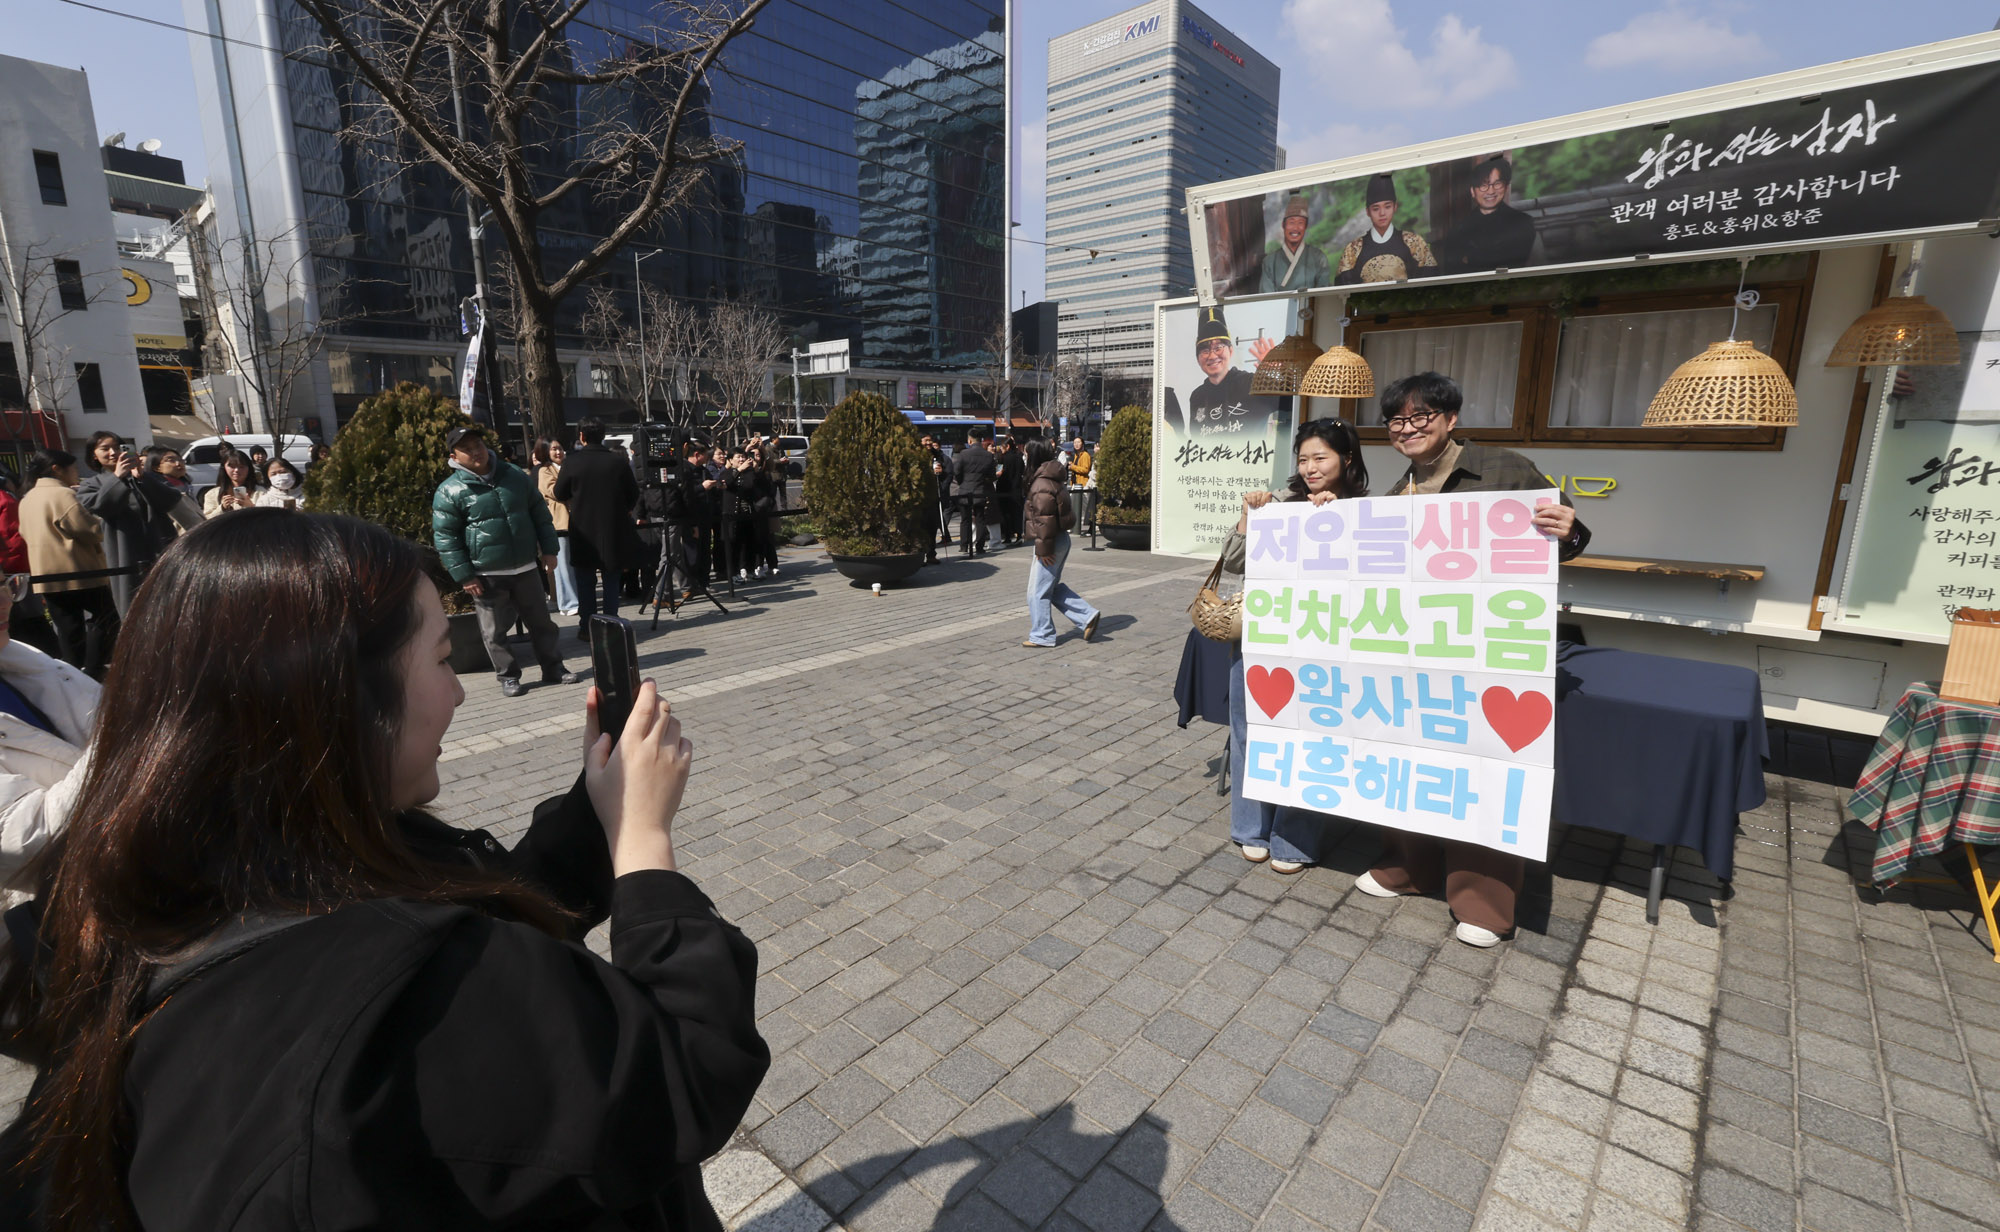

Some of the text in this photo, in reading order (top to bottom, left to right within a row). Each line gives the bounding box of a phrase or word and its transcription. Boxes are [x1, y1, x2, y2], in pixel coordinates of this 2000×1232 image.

[1123, 13, 1162, 42] KMI
[1625, 99, 1897, 190] 왕과 사는 남자
[1609, 166, 1901, 224] 관객 여러분 감사합니다
[1662, 207, 1824, 241] 흥도&홍위&항준
[138, 337, 166, 345] HOTEL
[1174, 439, 1275, 468] 왕과 사는 남자
[1906, 447, 2000, 494] 왕과
[1177, 475, 1270, 489] 사랑해주시는 관객분들께
[1187, 488, 1210, 499] 감사의
[1212, 489, 1237, 501] 마음을
[1194, 502, 1217, 513] 커피를
[1909, 507, 2000, 525] 사랑해주
[1193, 522, 1214, 532] 관객과
[1933, 529, 1996, 548] 감사의
[1937, 584, 1996, 602] 관객과
[1298, 663, 1477, 745] 왕사남
